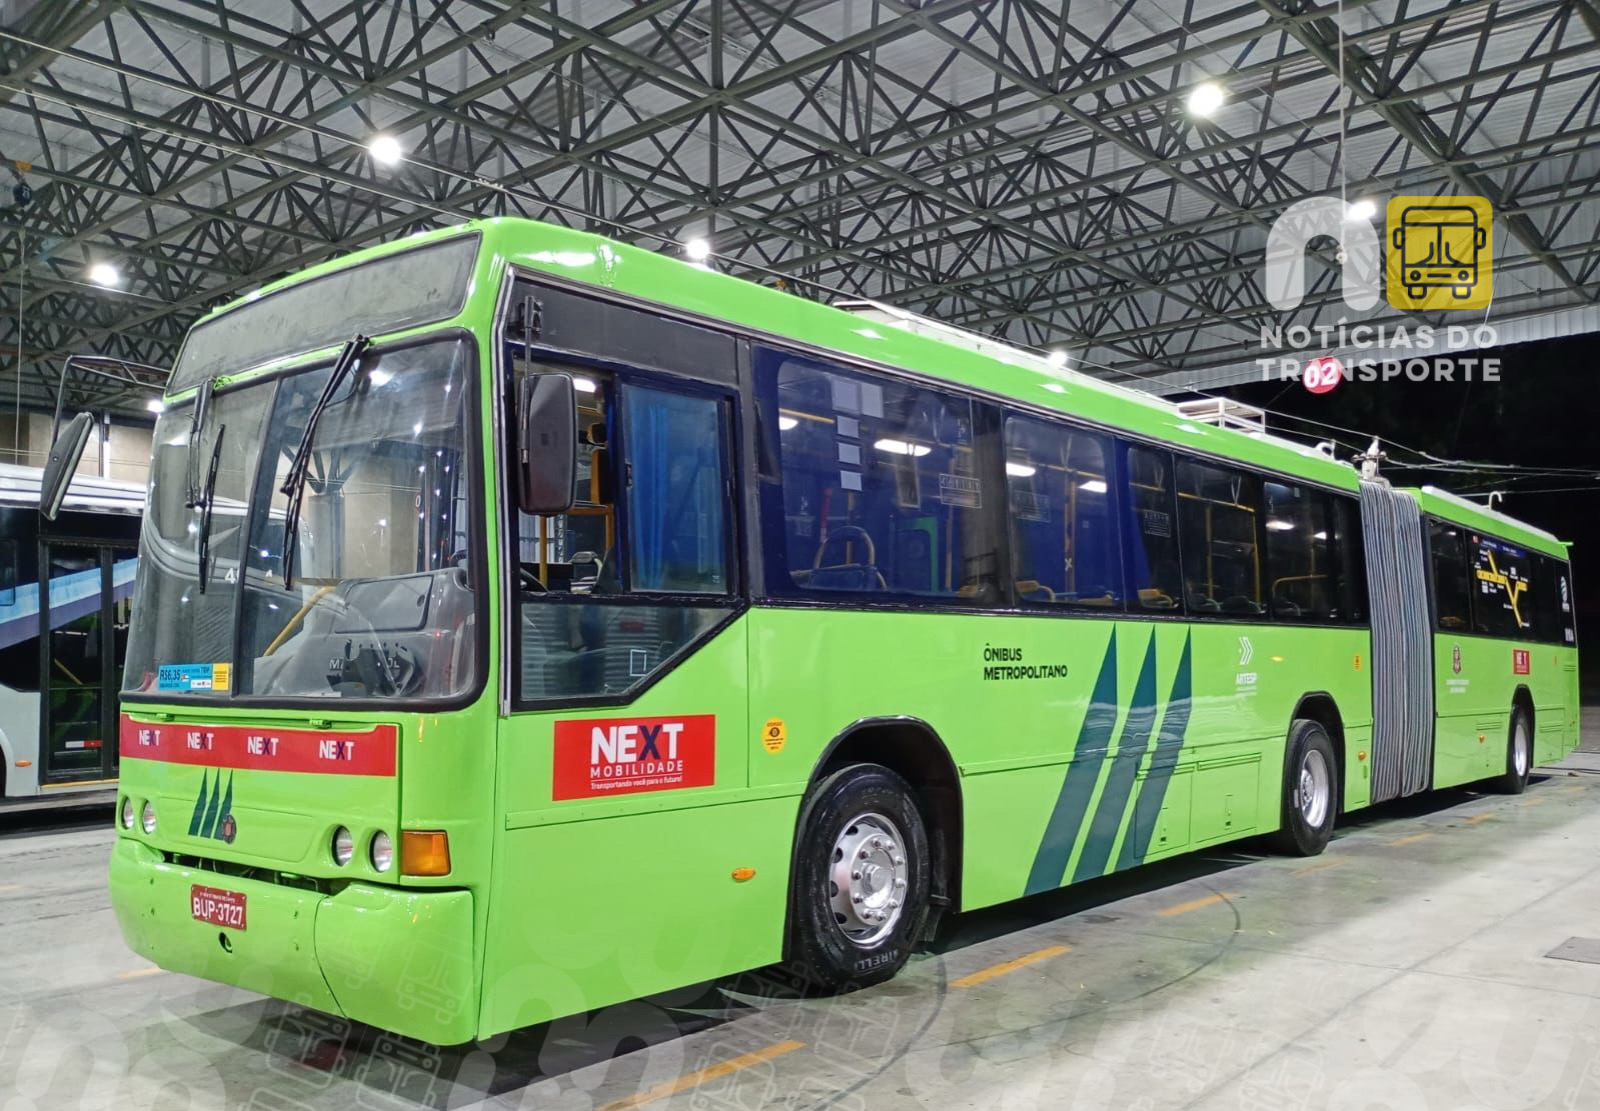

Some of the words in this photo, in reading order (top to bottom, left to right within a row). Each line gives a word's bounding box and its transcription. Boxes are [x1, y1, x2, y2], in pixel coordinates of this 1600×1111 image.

[1303, 361, 1338, 388] 02
[983, 642, 1023, 662] ÔNIBUS
[983, 664, 1068, 681] METROPOLITANO
[138, 729, 161, 747] NEXT
[186, 732, 215, 751] NEXT
[246, 735, 280, 756] NEXT
[590, 723, 684, 765] NEXT
[318, 739, 355, 761] NEXT
[589, 760, 684, 779] MOBILIDADE
